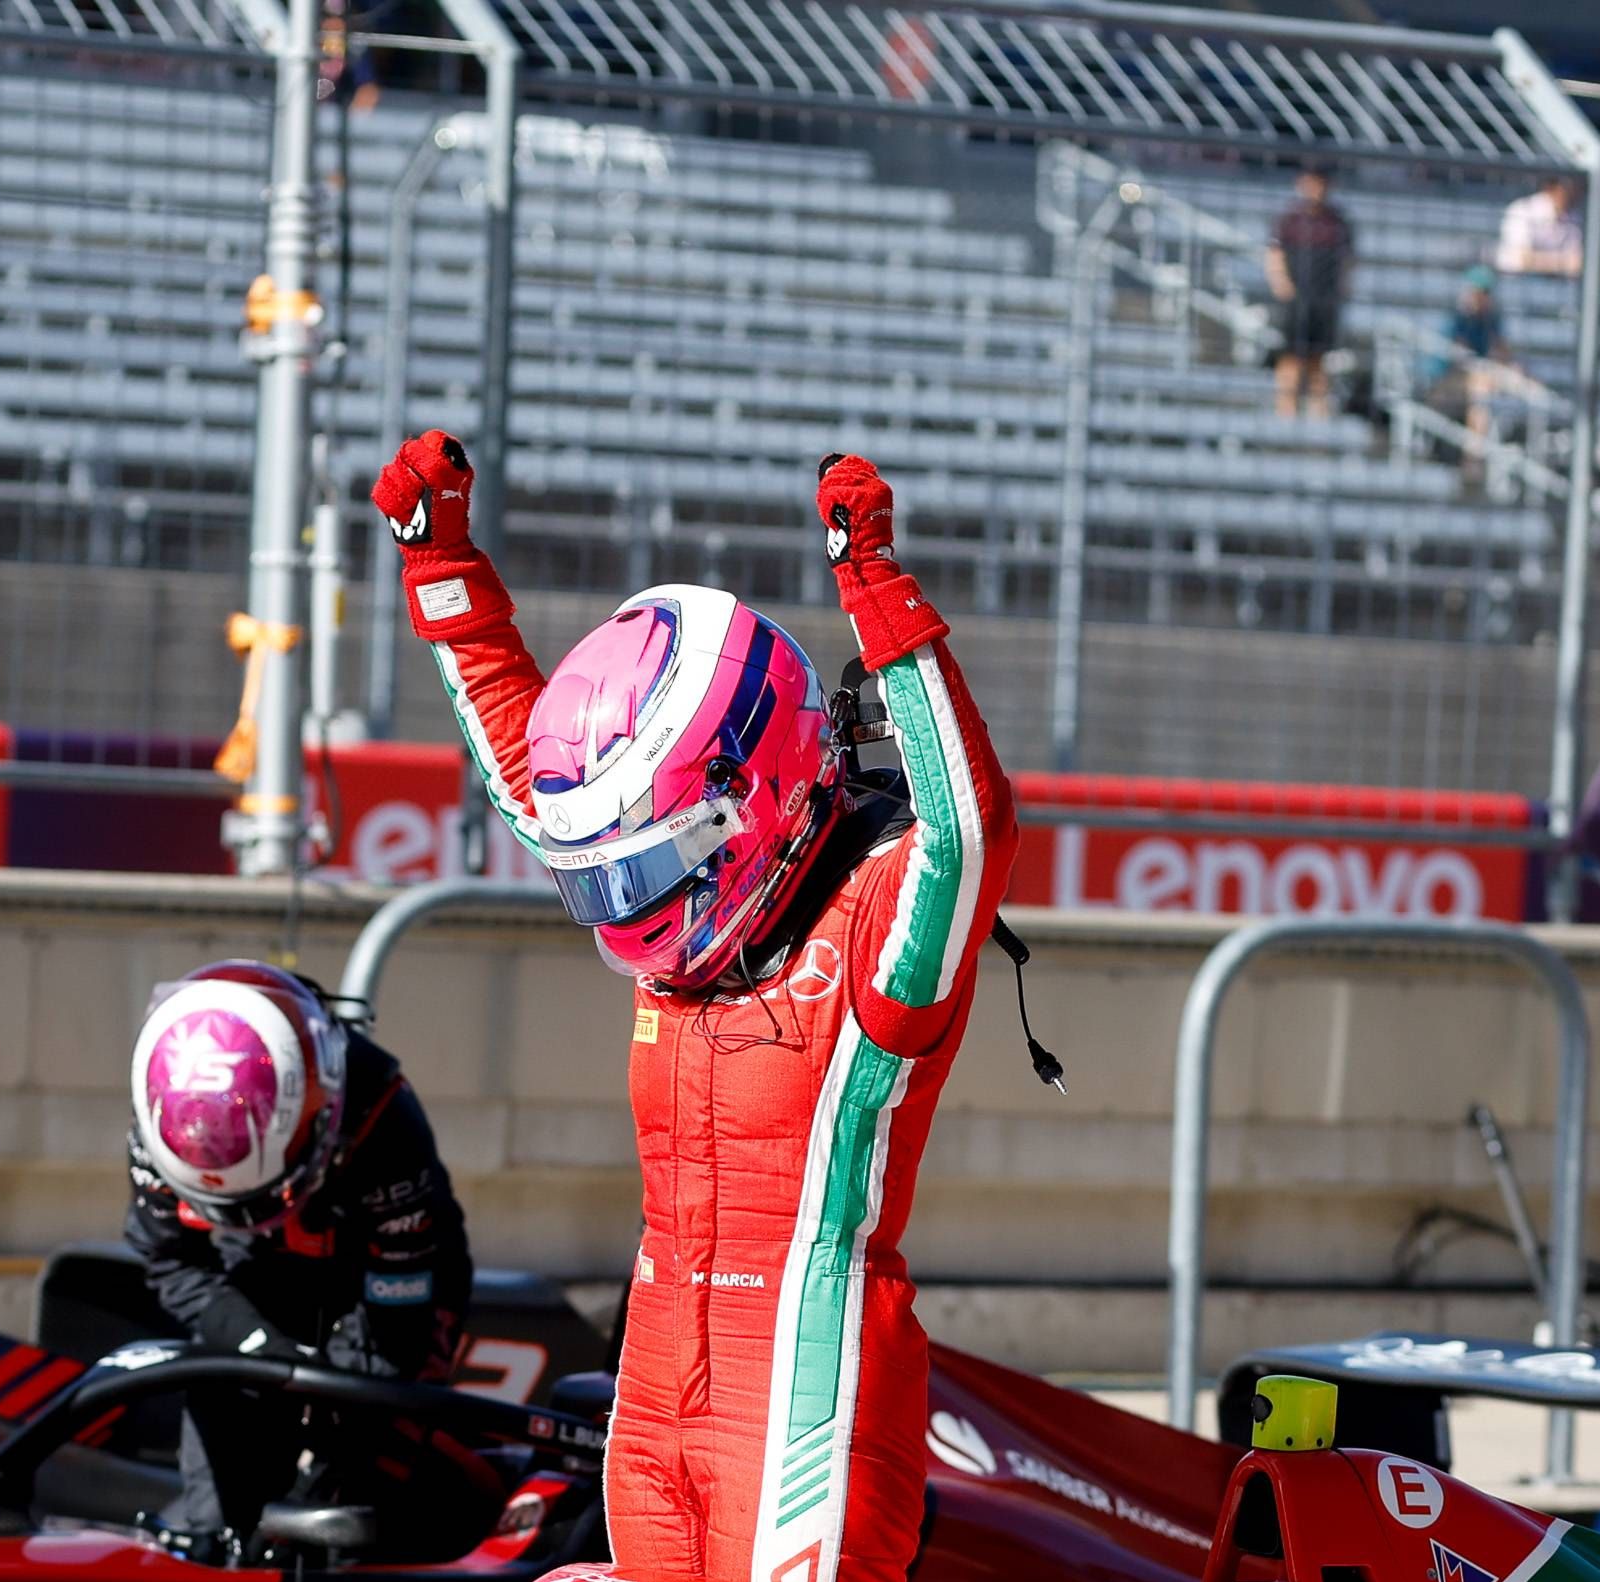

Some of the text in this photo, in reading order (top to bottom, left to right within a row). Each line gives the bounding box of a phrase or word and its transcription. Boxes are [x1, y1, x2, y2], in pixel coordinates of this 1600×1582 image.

[667, 815, 693, 832] BELL
[546, 851, 609, 867] REMA
[1053, 825, 1484, 923] Lenovo
[1388, 1464, 1433, 1517] E
